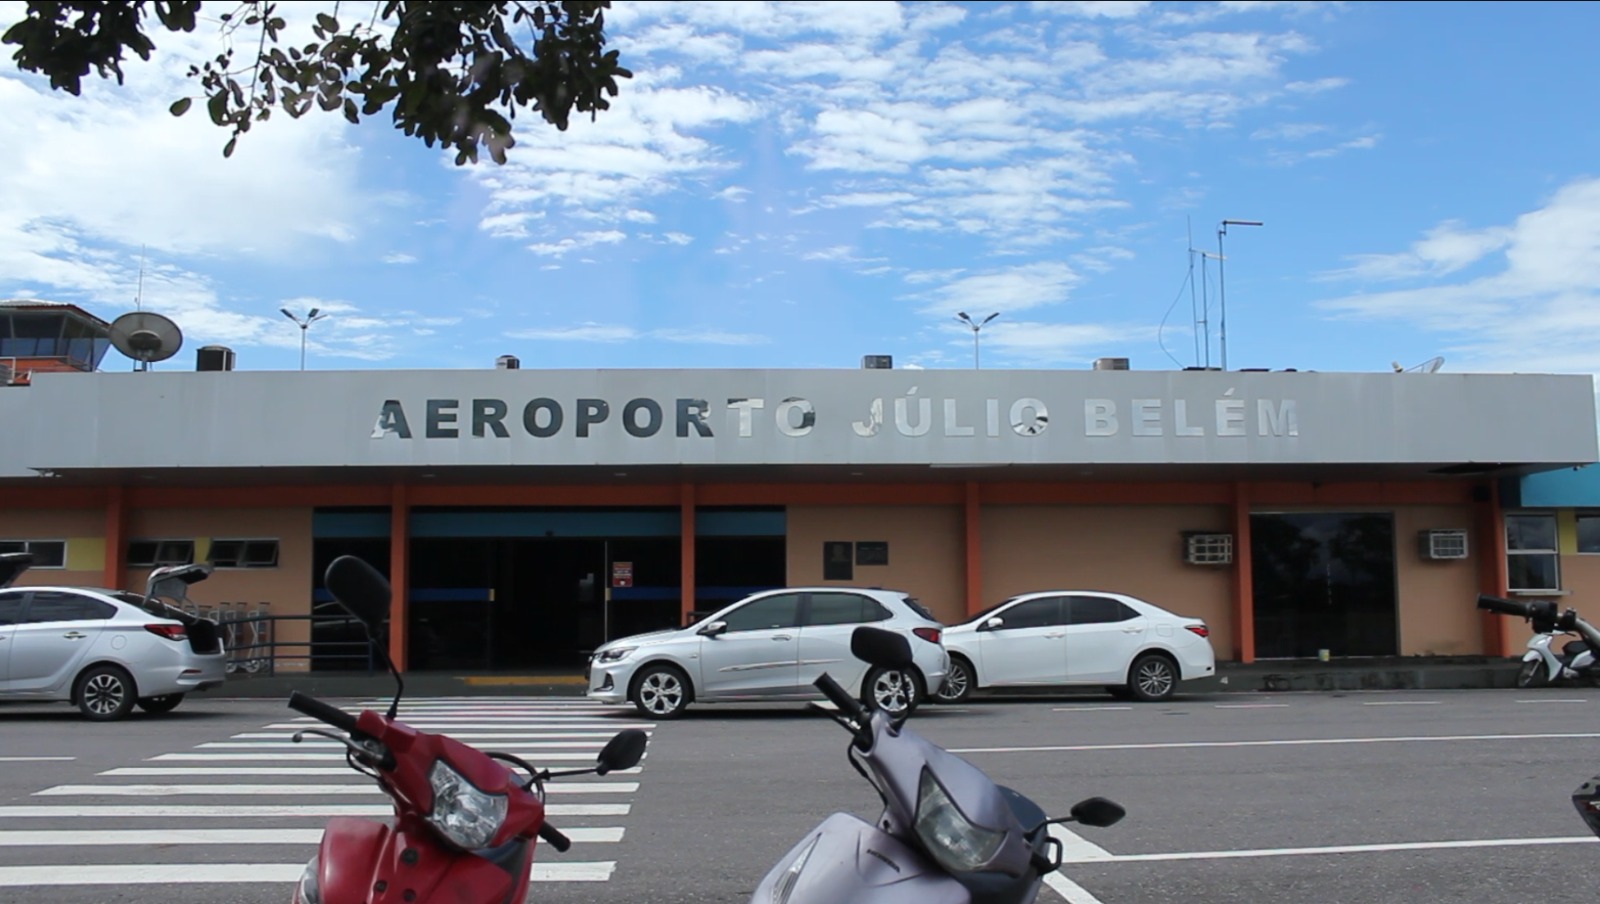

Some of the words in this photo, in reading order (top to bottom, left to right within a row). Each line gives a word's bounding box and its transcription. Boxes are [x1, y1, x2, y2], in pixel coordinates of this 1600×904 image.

[371, 397, 816, 439] AEROPORTO
[852, 386, 1049, 438] JÚLIO
[1084, 387, 1299, 437] BELÉM
